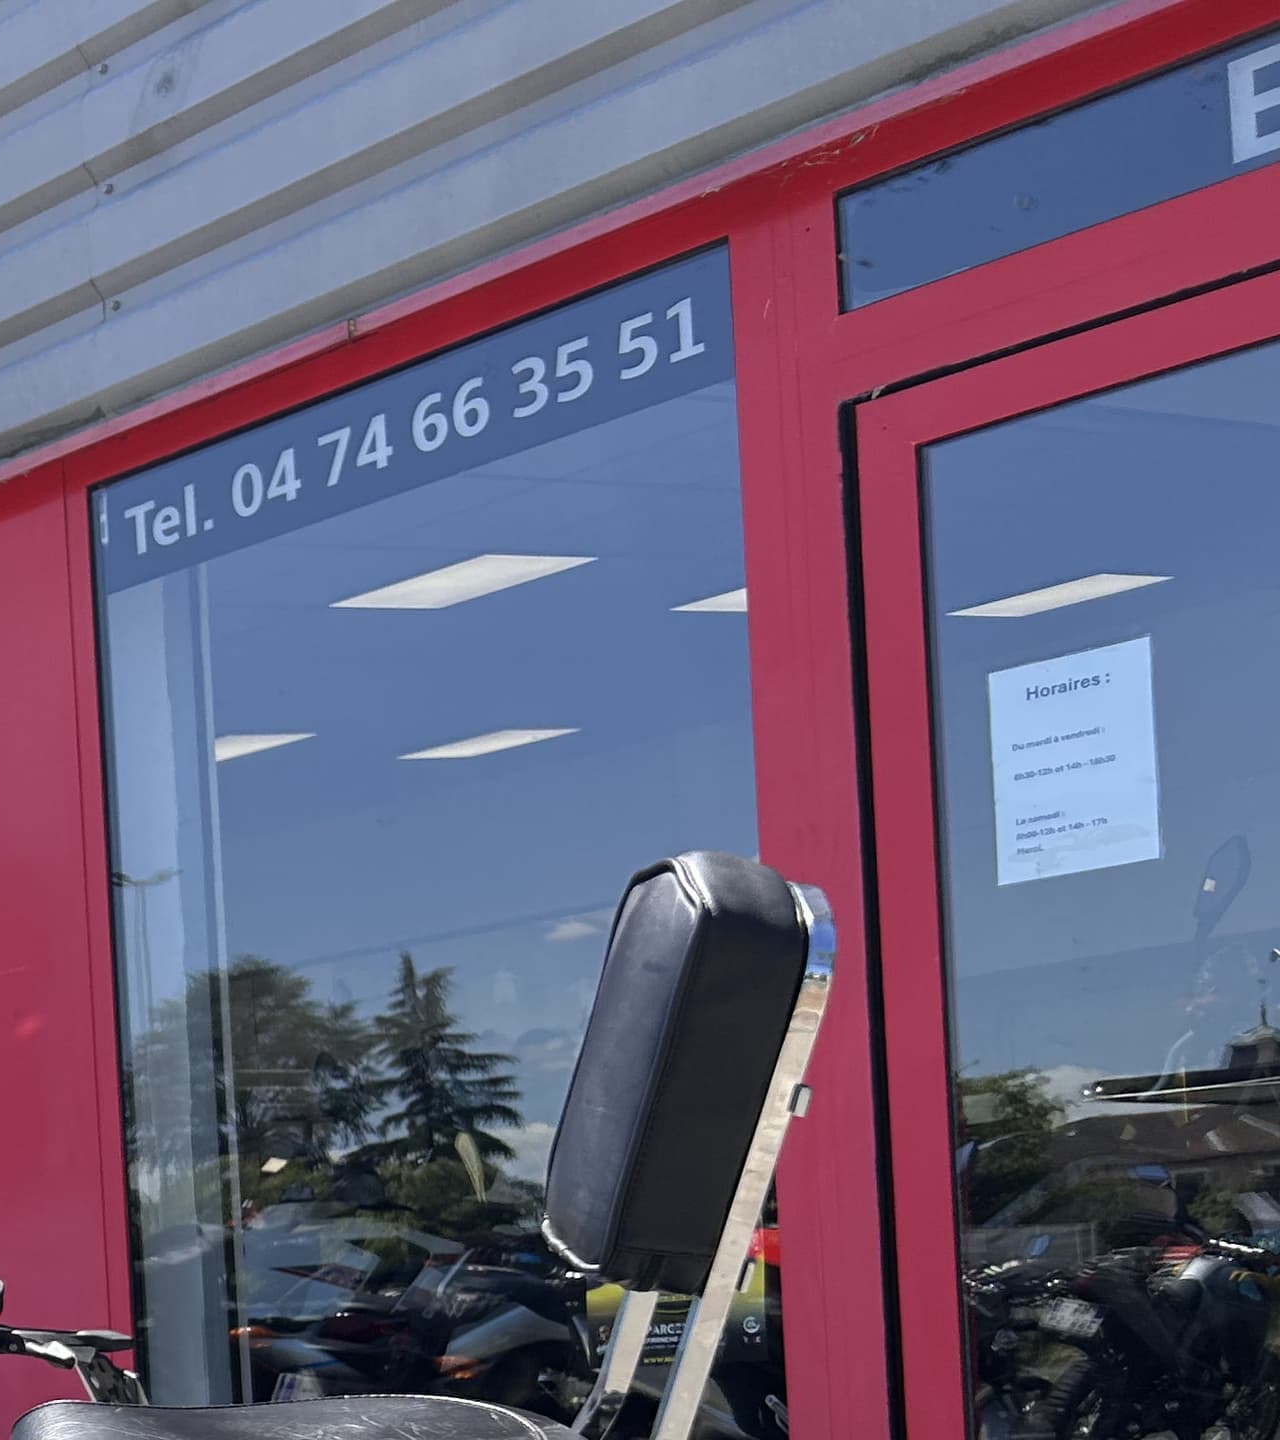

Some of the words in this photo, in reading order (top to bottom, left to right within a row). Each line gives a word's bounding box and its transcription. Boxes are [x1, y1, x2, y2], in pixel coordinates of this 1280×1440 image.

[124, 483, 214, 555] Tel.
[231, 447, 302, 518] 04
[317, 413, 393, 487] 74
[411, 376, 491, 451] 66
[511, 336, 594, 418] 35
[618, 297, 706, 381] 51
[1025, 673, 1101, 700] Horaires
